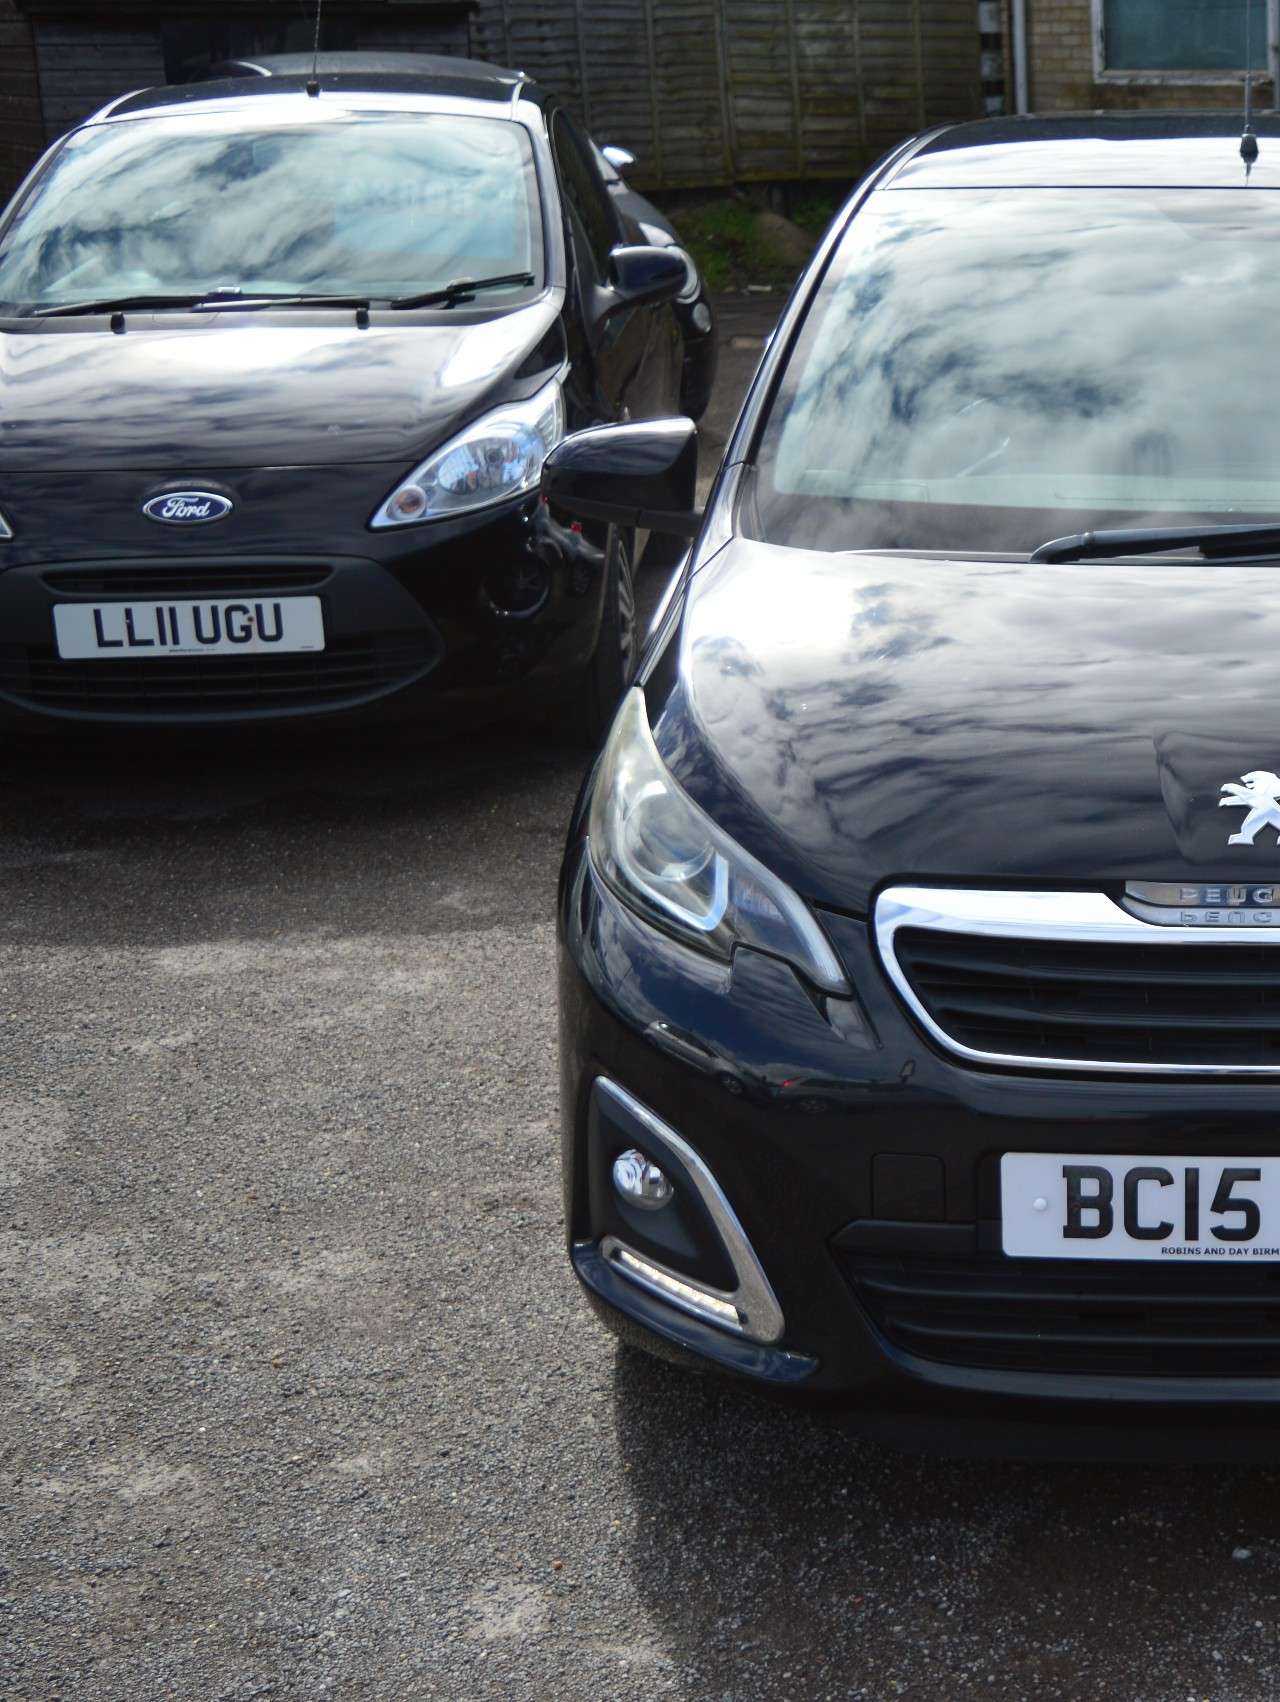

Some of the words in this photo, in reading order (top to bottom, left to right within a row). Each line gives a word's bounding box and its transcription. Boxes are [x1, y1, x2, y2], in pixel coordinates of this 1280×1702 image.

[161, 496, 212, 518] Ford
[93, 605, 180, 648] LL11
[192, 603, 284, 645] UGU
[1062, 1164, 1261, 1242] BC15
[1161, 1246, 1201, 1256] ROBINS
[1203, 1246, 1226, 1256] AND
[1228, 1247, 1250, 1256] DAY
